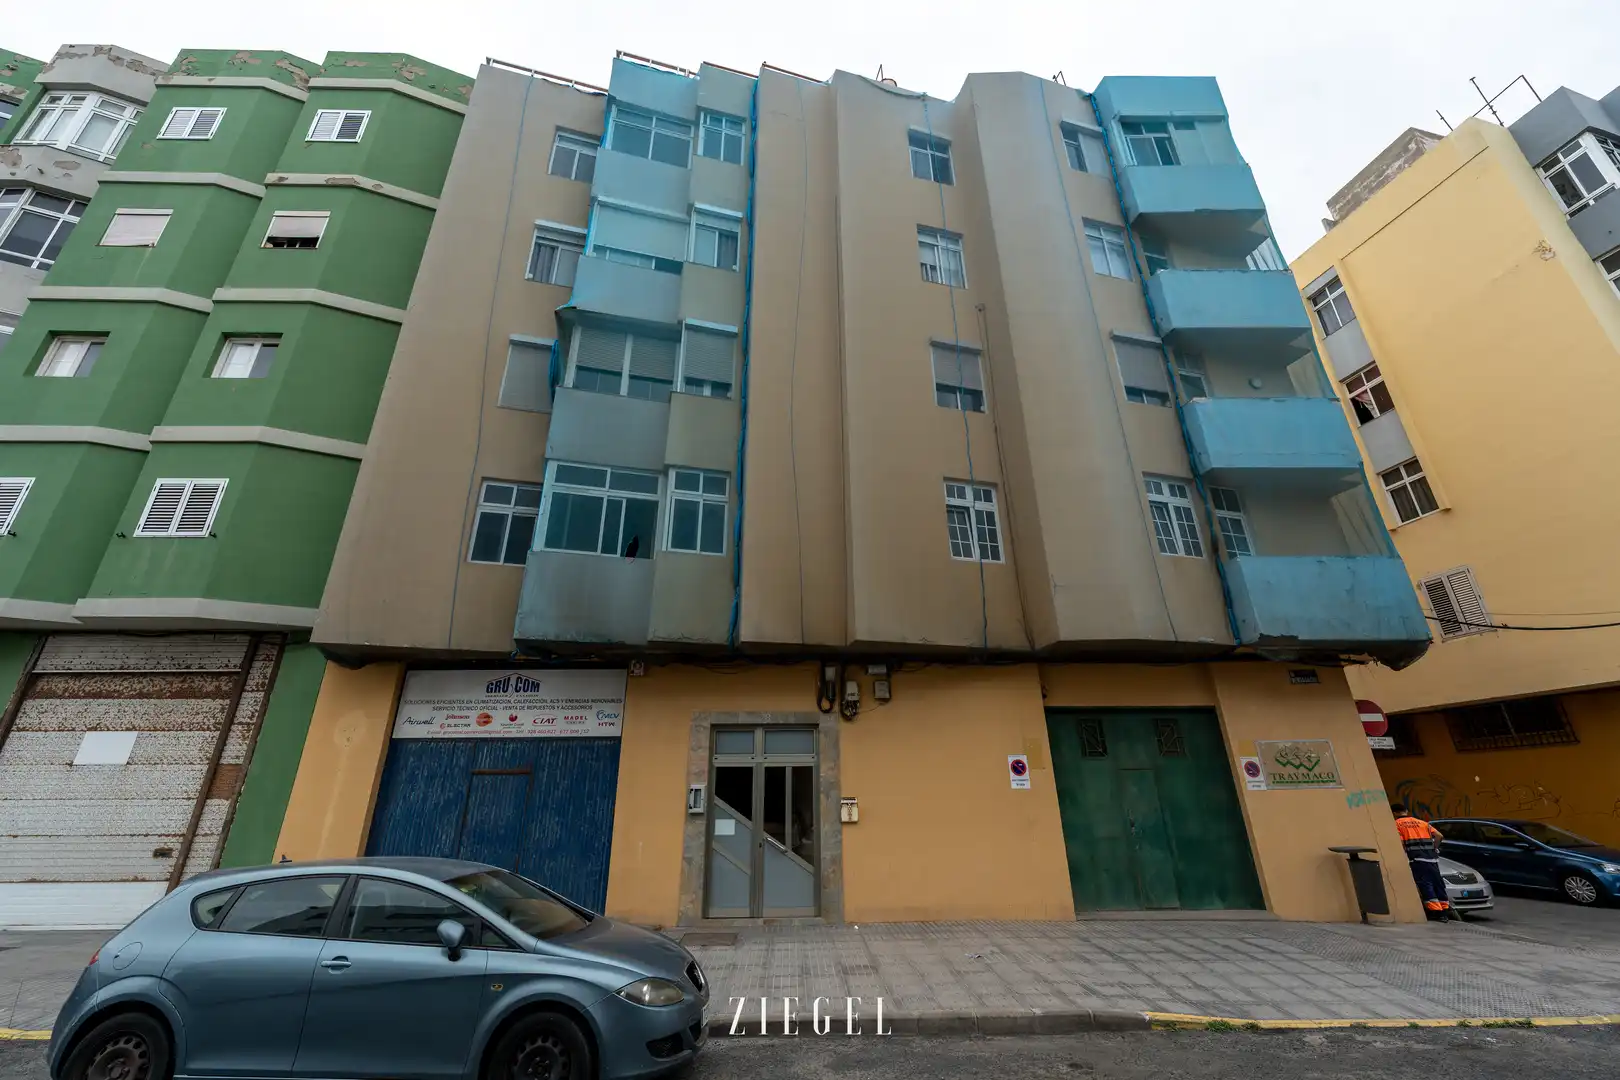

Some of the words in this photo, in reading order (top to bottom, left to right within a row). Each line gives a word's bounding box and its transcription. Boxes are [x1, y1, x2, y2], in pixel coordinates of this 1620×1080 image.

[402, 716, 436, 725] Airwell
[533, 717, 558, 725] CIAT
[1269, 771, 1335, 781] TRAYMACO
